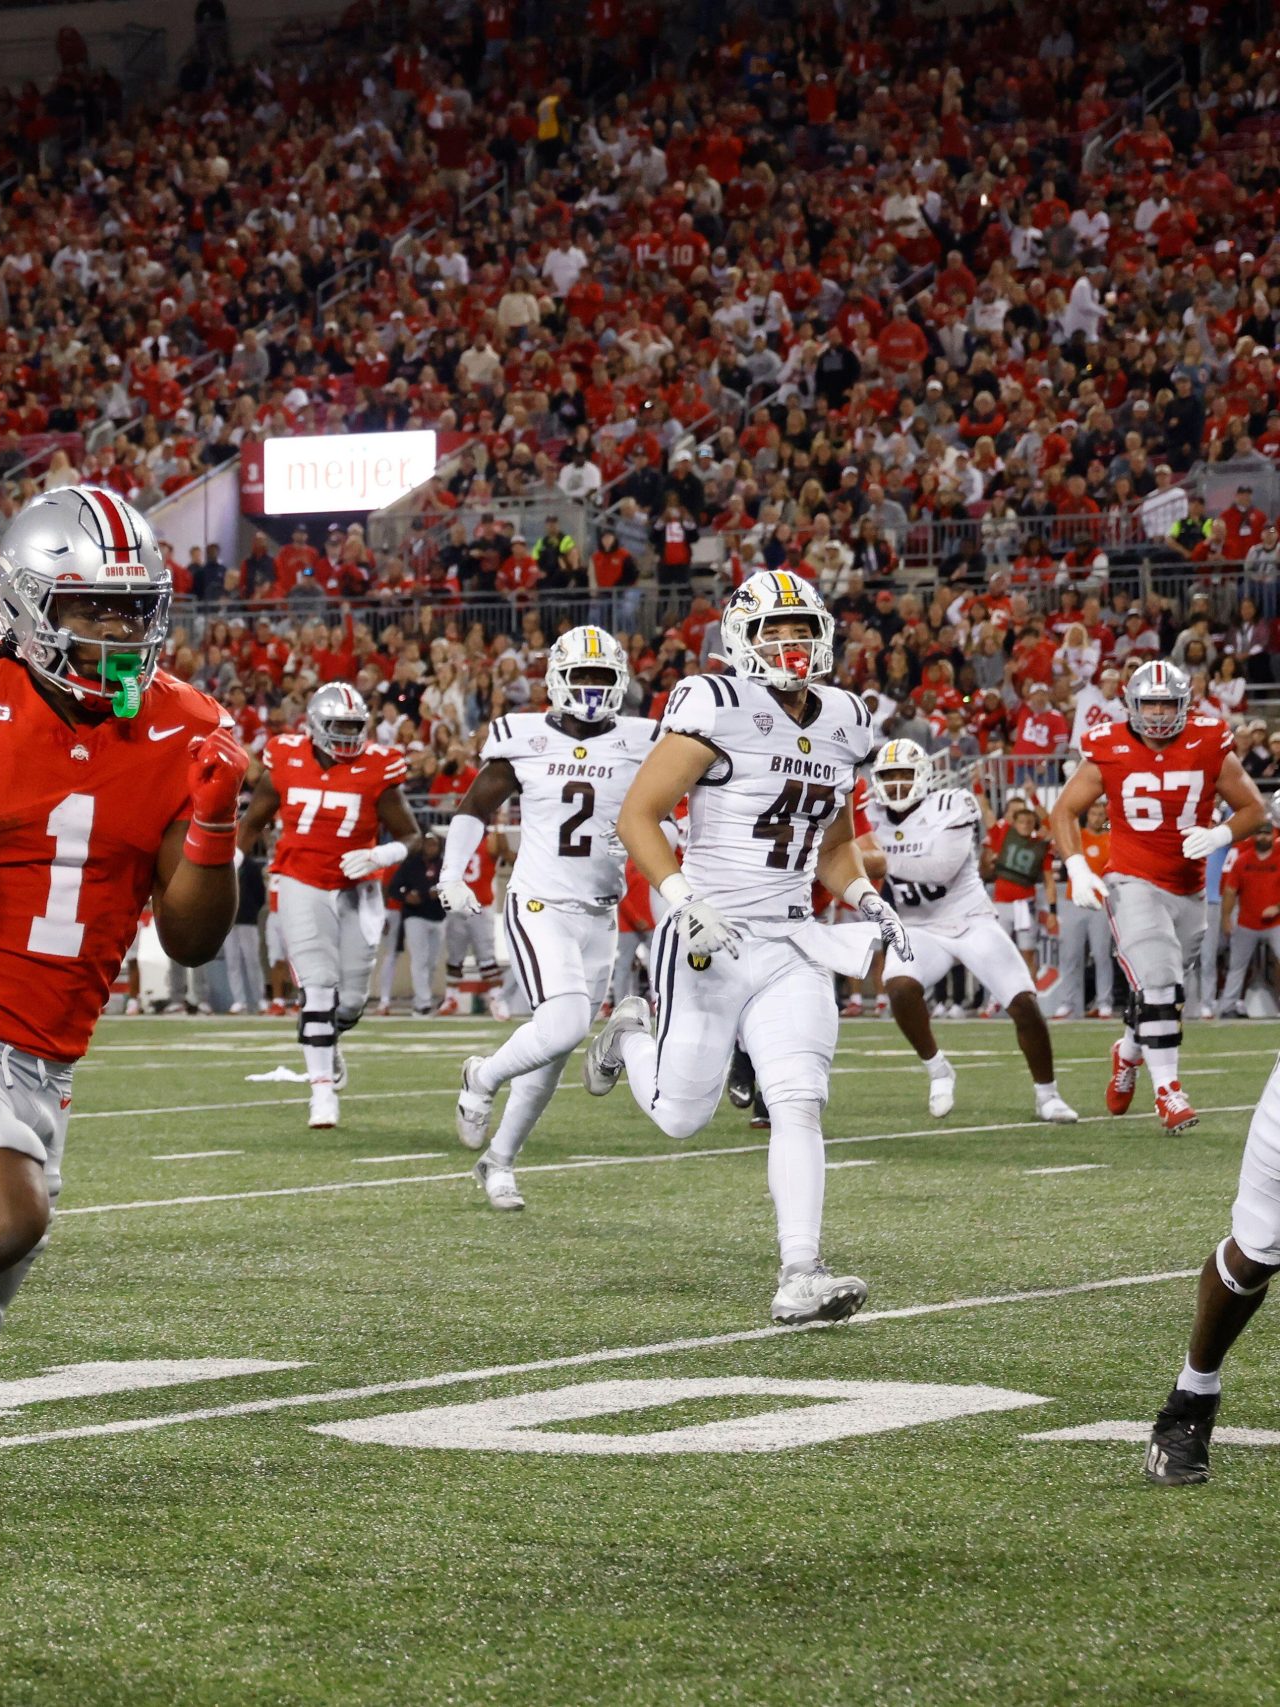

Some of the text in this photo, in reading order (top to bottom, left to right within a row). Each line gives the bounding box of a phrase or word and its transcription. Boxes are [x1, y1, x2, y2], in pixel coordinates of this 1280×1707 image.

[106, 566, 146, 577] OHIO STATE
[782, 597, 800, 605] EAT
[547, 763, 614, 779] BRONCOS
[770, 756, 836, 782] BRONCOS
[287, 787, 362, 838] 77
[558, 781, 595, 857] 2
[752, 779, 837, 871] 47
[1121, 770, 1204, 831] 67
[27, 793, 95, 958] 1
